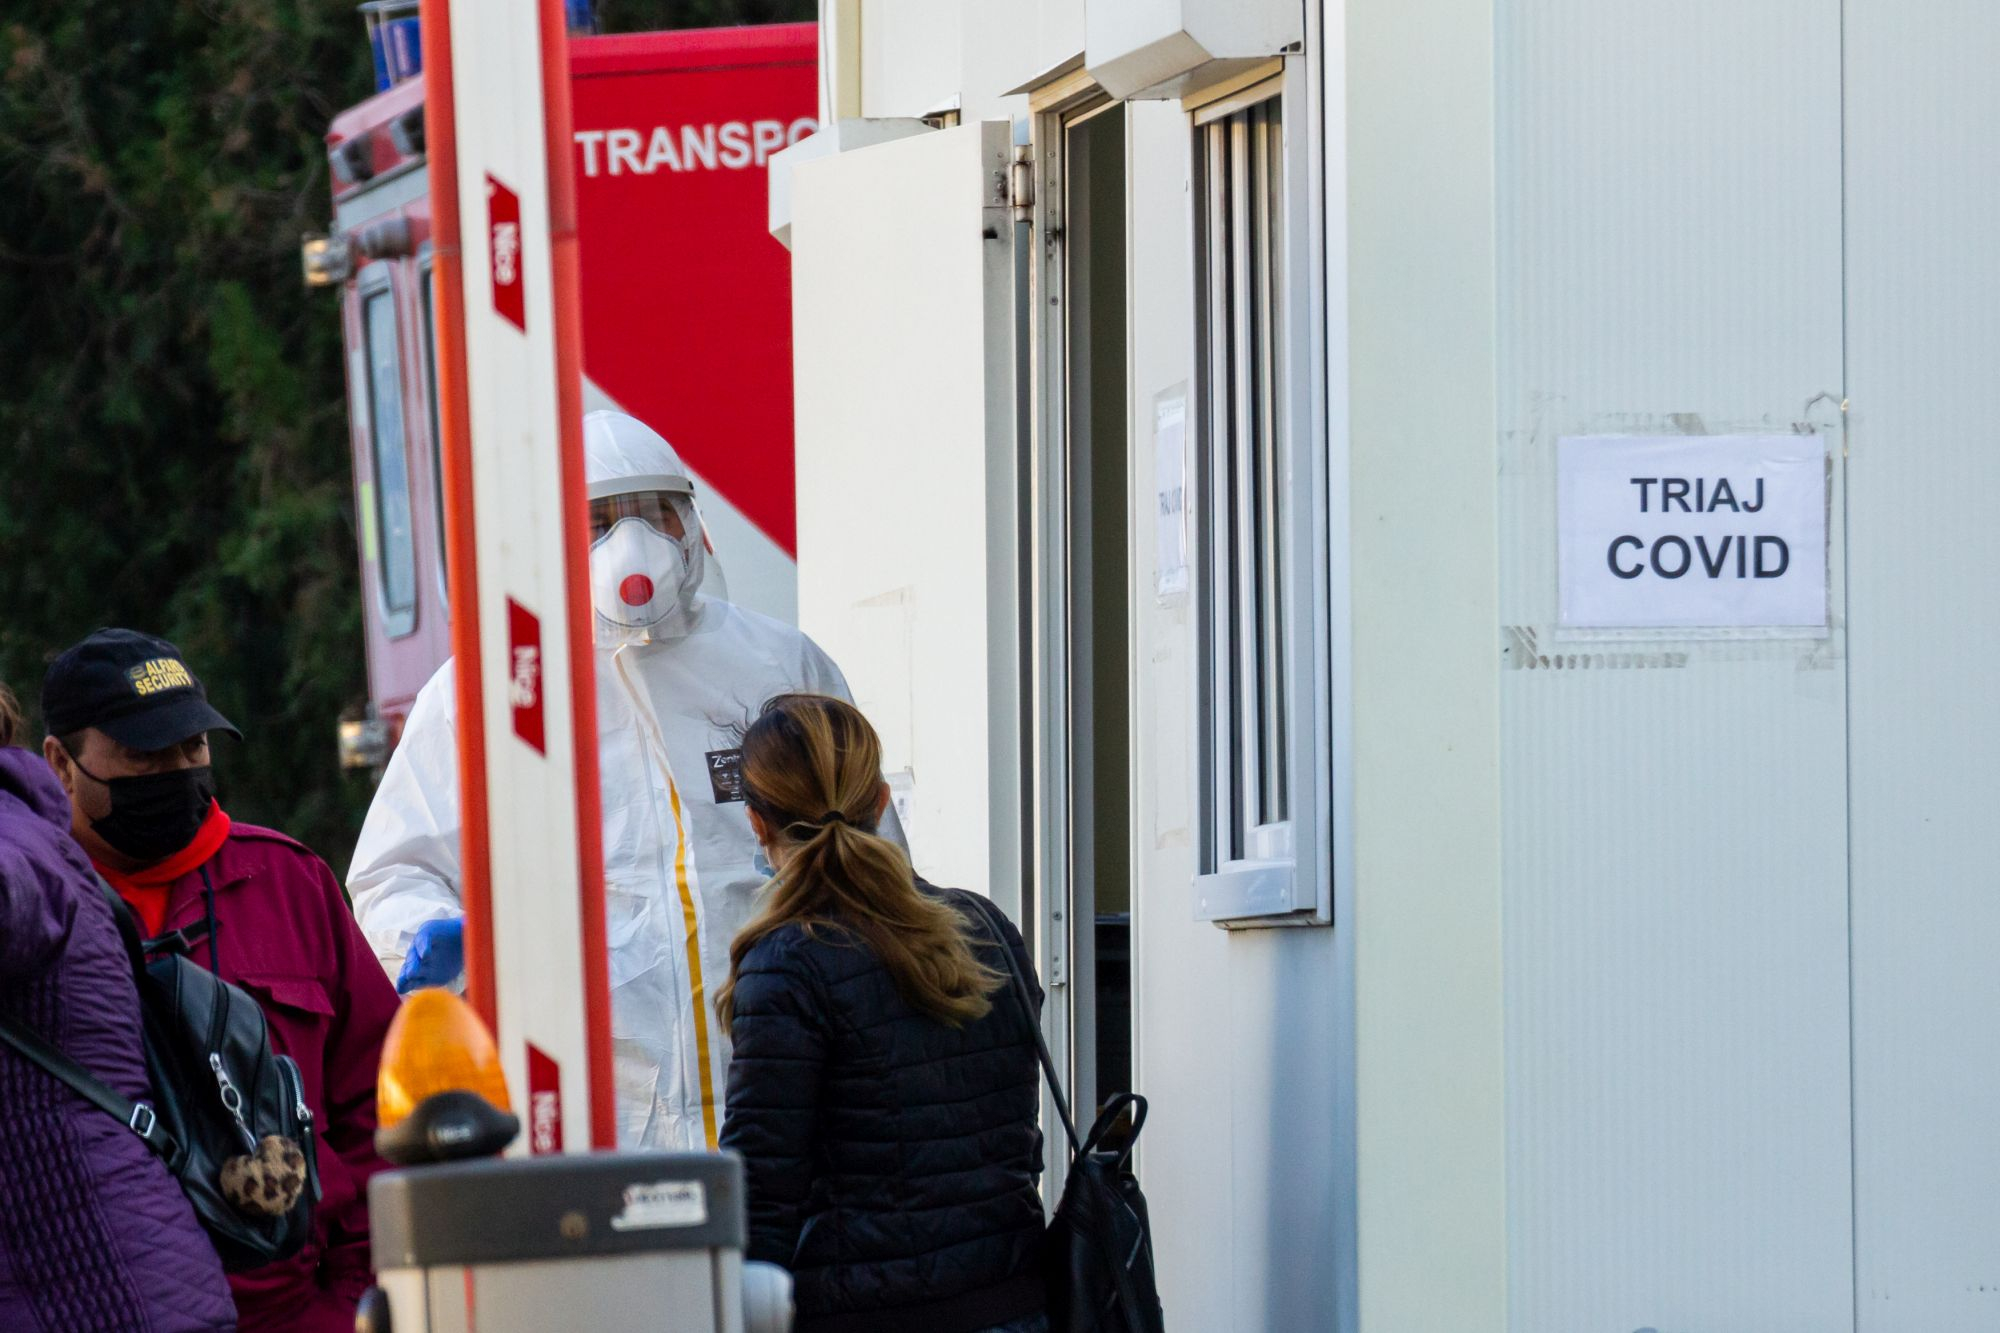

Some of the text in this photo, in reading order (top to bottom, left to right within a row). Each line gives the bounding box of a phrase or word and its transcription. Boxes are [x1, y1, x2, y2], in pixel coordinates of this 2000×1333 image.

[493, 222, 519, 287] Nice
[1630, 477, 1764, 513] TRIAJ
[1607, 534, 1790, 580] COVID
[135, 671, 193, 695] SECURITY
